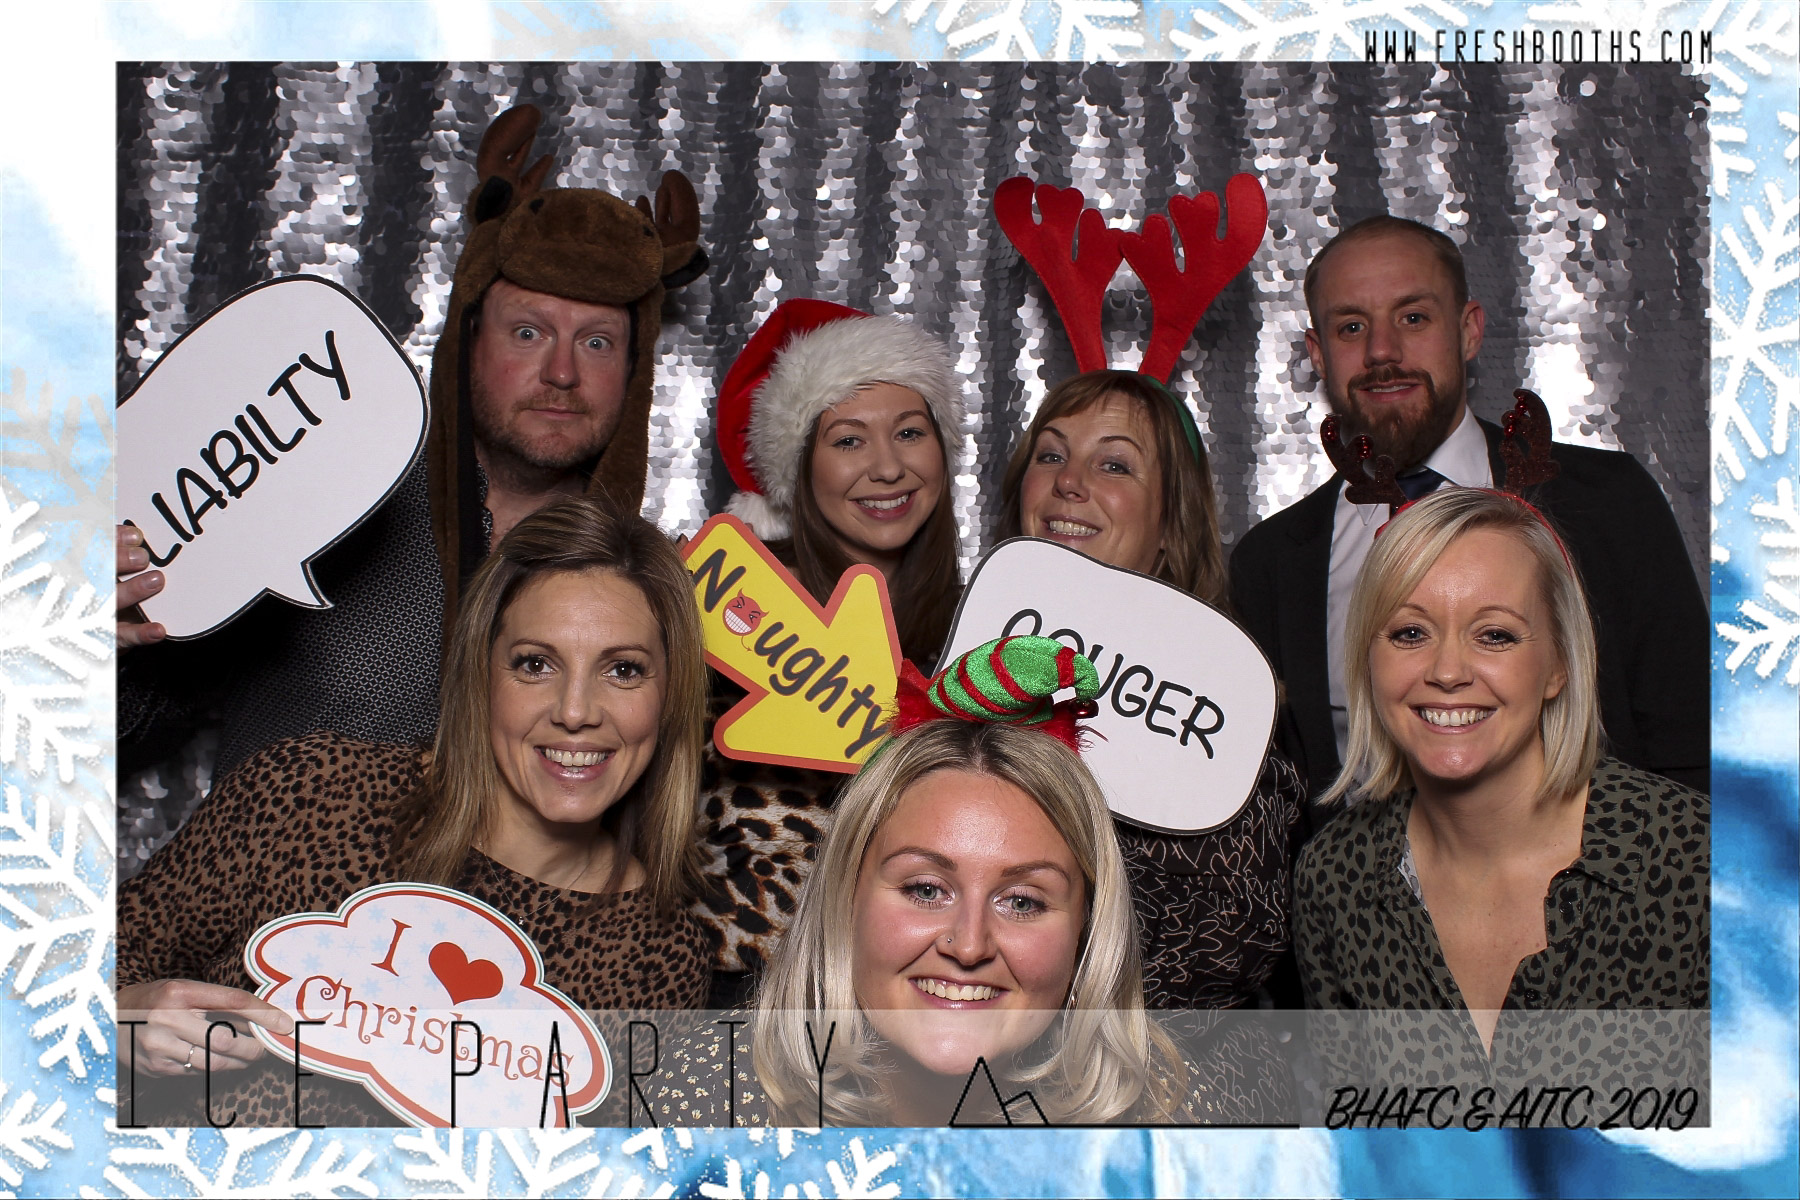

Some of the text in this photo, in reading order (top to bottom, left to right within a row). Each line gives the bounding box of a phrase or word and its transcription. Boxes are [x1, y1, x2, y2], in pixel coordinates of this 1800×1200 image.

[123, 329, 351, 568] LIABILTY
[371, 918, 412, 977] I
[295, 974, 575, 1088] Christmas
